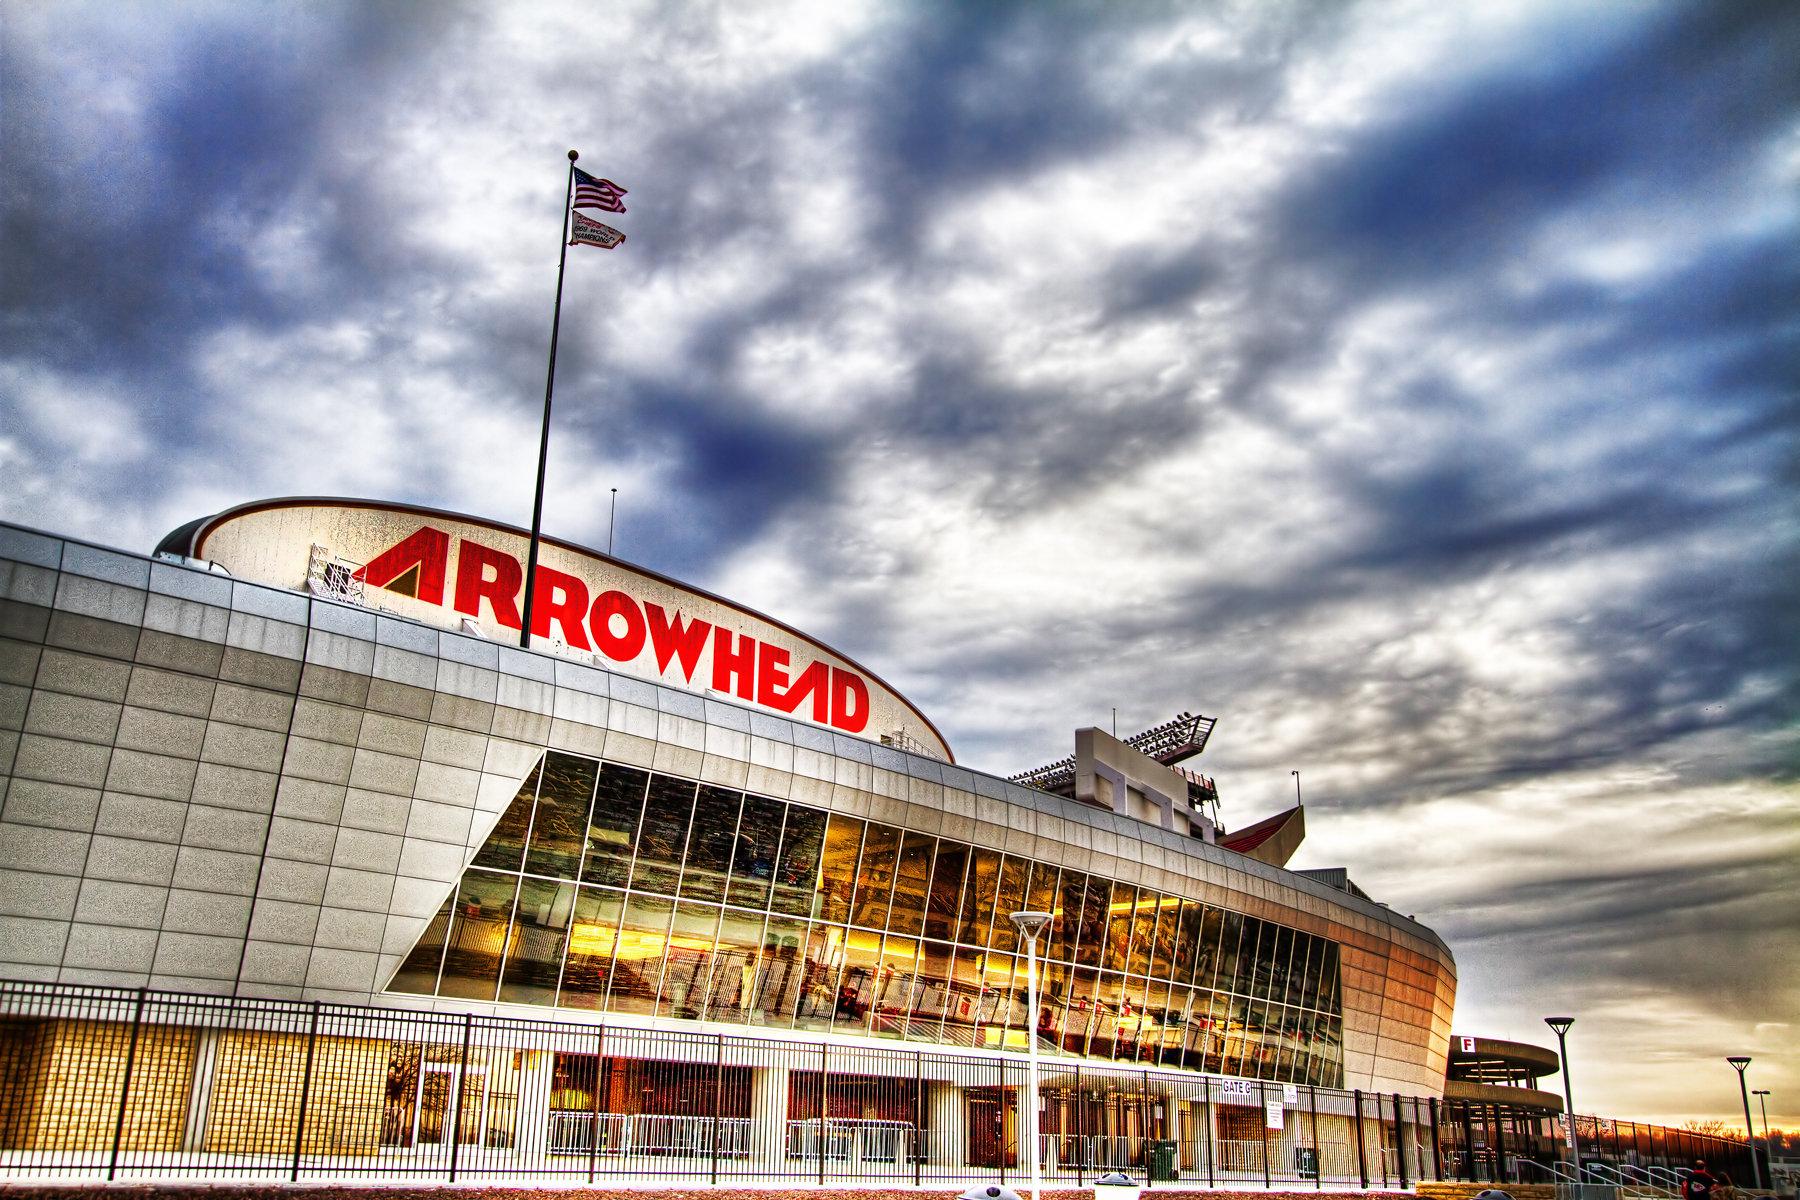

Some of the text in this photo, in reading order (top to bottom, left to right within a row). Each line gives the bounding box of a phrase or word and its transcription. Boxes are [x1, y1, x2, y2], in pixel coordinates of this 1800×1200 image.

[574, 232, 609, 243] HAMPIONS
[353, 526, 870, 733] ARROWHEAD
[1463, 1039, 1472, 1050] F
[1223, 1081, 1251, 1094] GATE G
